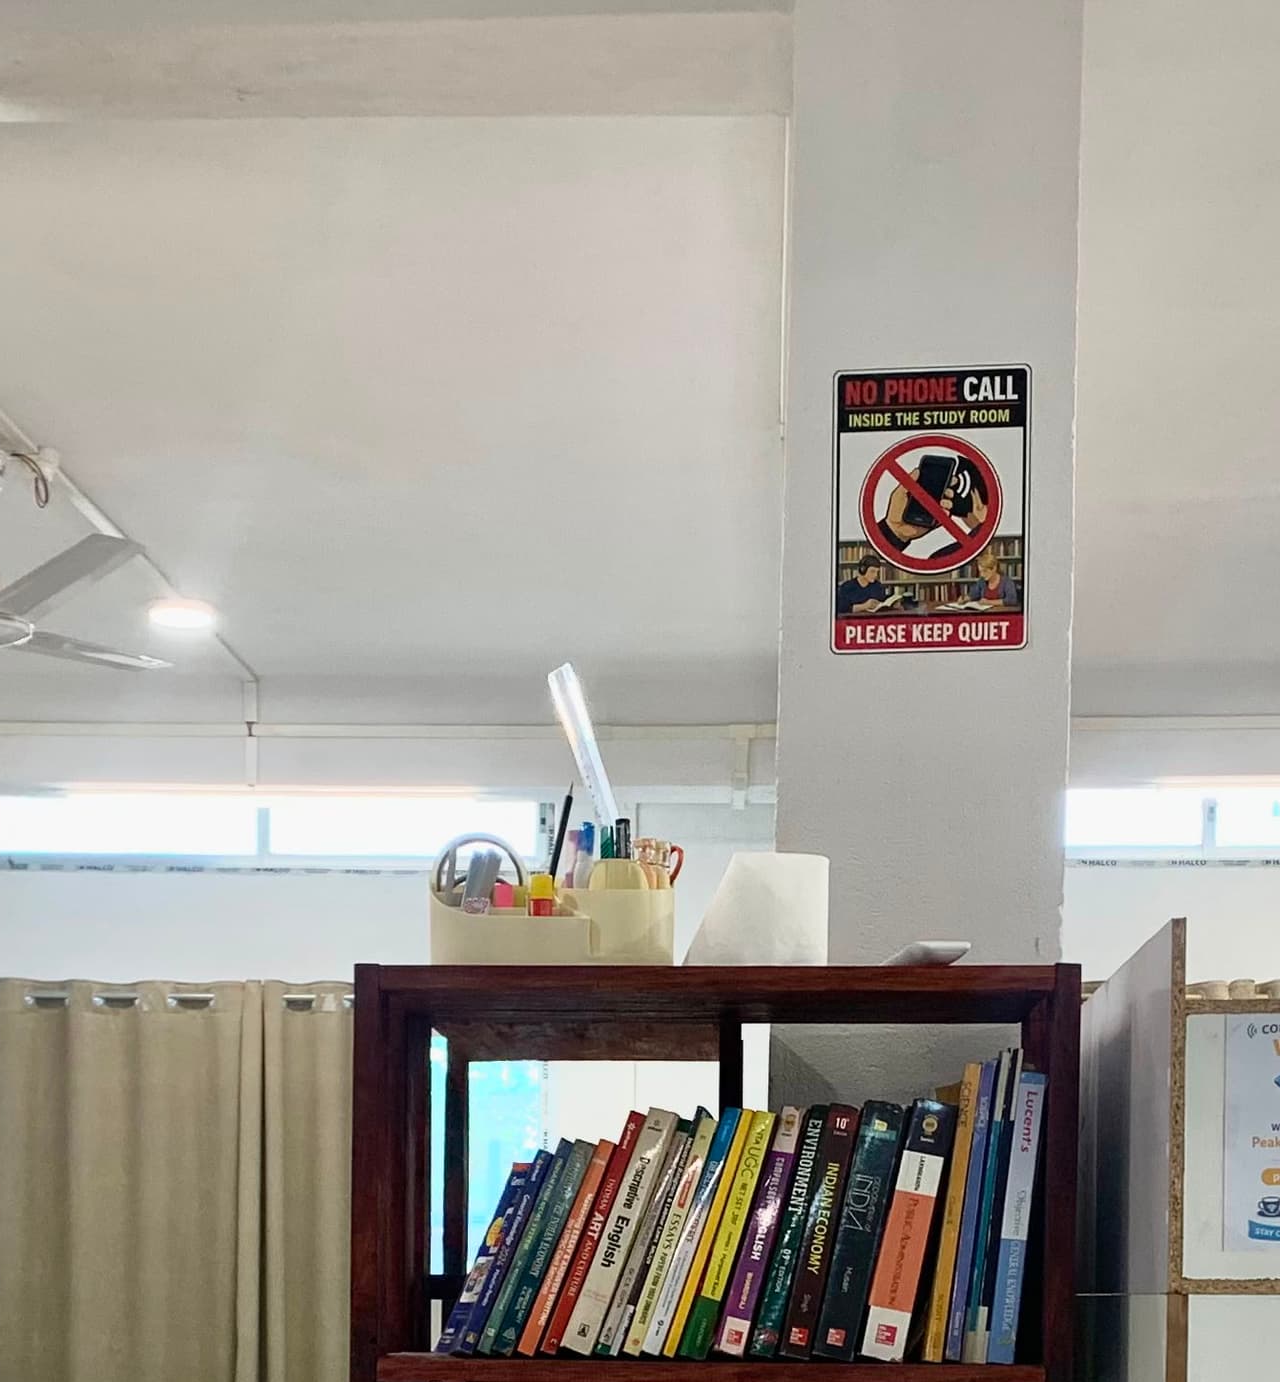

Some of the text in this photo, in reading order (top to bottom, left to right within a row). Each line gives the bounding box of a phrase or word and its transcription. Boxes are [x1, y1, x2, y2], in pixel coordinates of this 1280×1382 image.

[845, 376, 1018, 405] NO PHONE CALL
[849, 409, 1010, 427] INSIDE THE STUDY ROOM
[846, 621, 1009, 643] PLEASE KEEP QUIET
[1020, 1090, 1039, 1153] Lucent's
[621, 1155, 651, 1211] Descriptive
[740, 1144, 761, 1179] UGC
[787, 1117, 822, 1215] ENVIRONMENT
[819, 1161, 839, 1207] INDIAN
[843, 1173, 874, 1231] INDIA
[566, 1177, 615, 1297] INDIAN ART AND CULTURE
[598, 1213, 631, 1270] English
[662, 1211, 682, 1250] ESSAYS
[805, 1208, 830, 1274] ECONOMY
